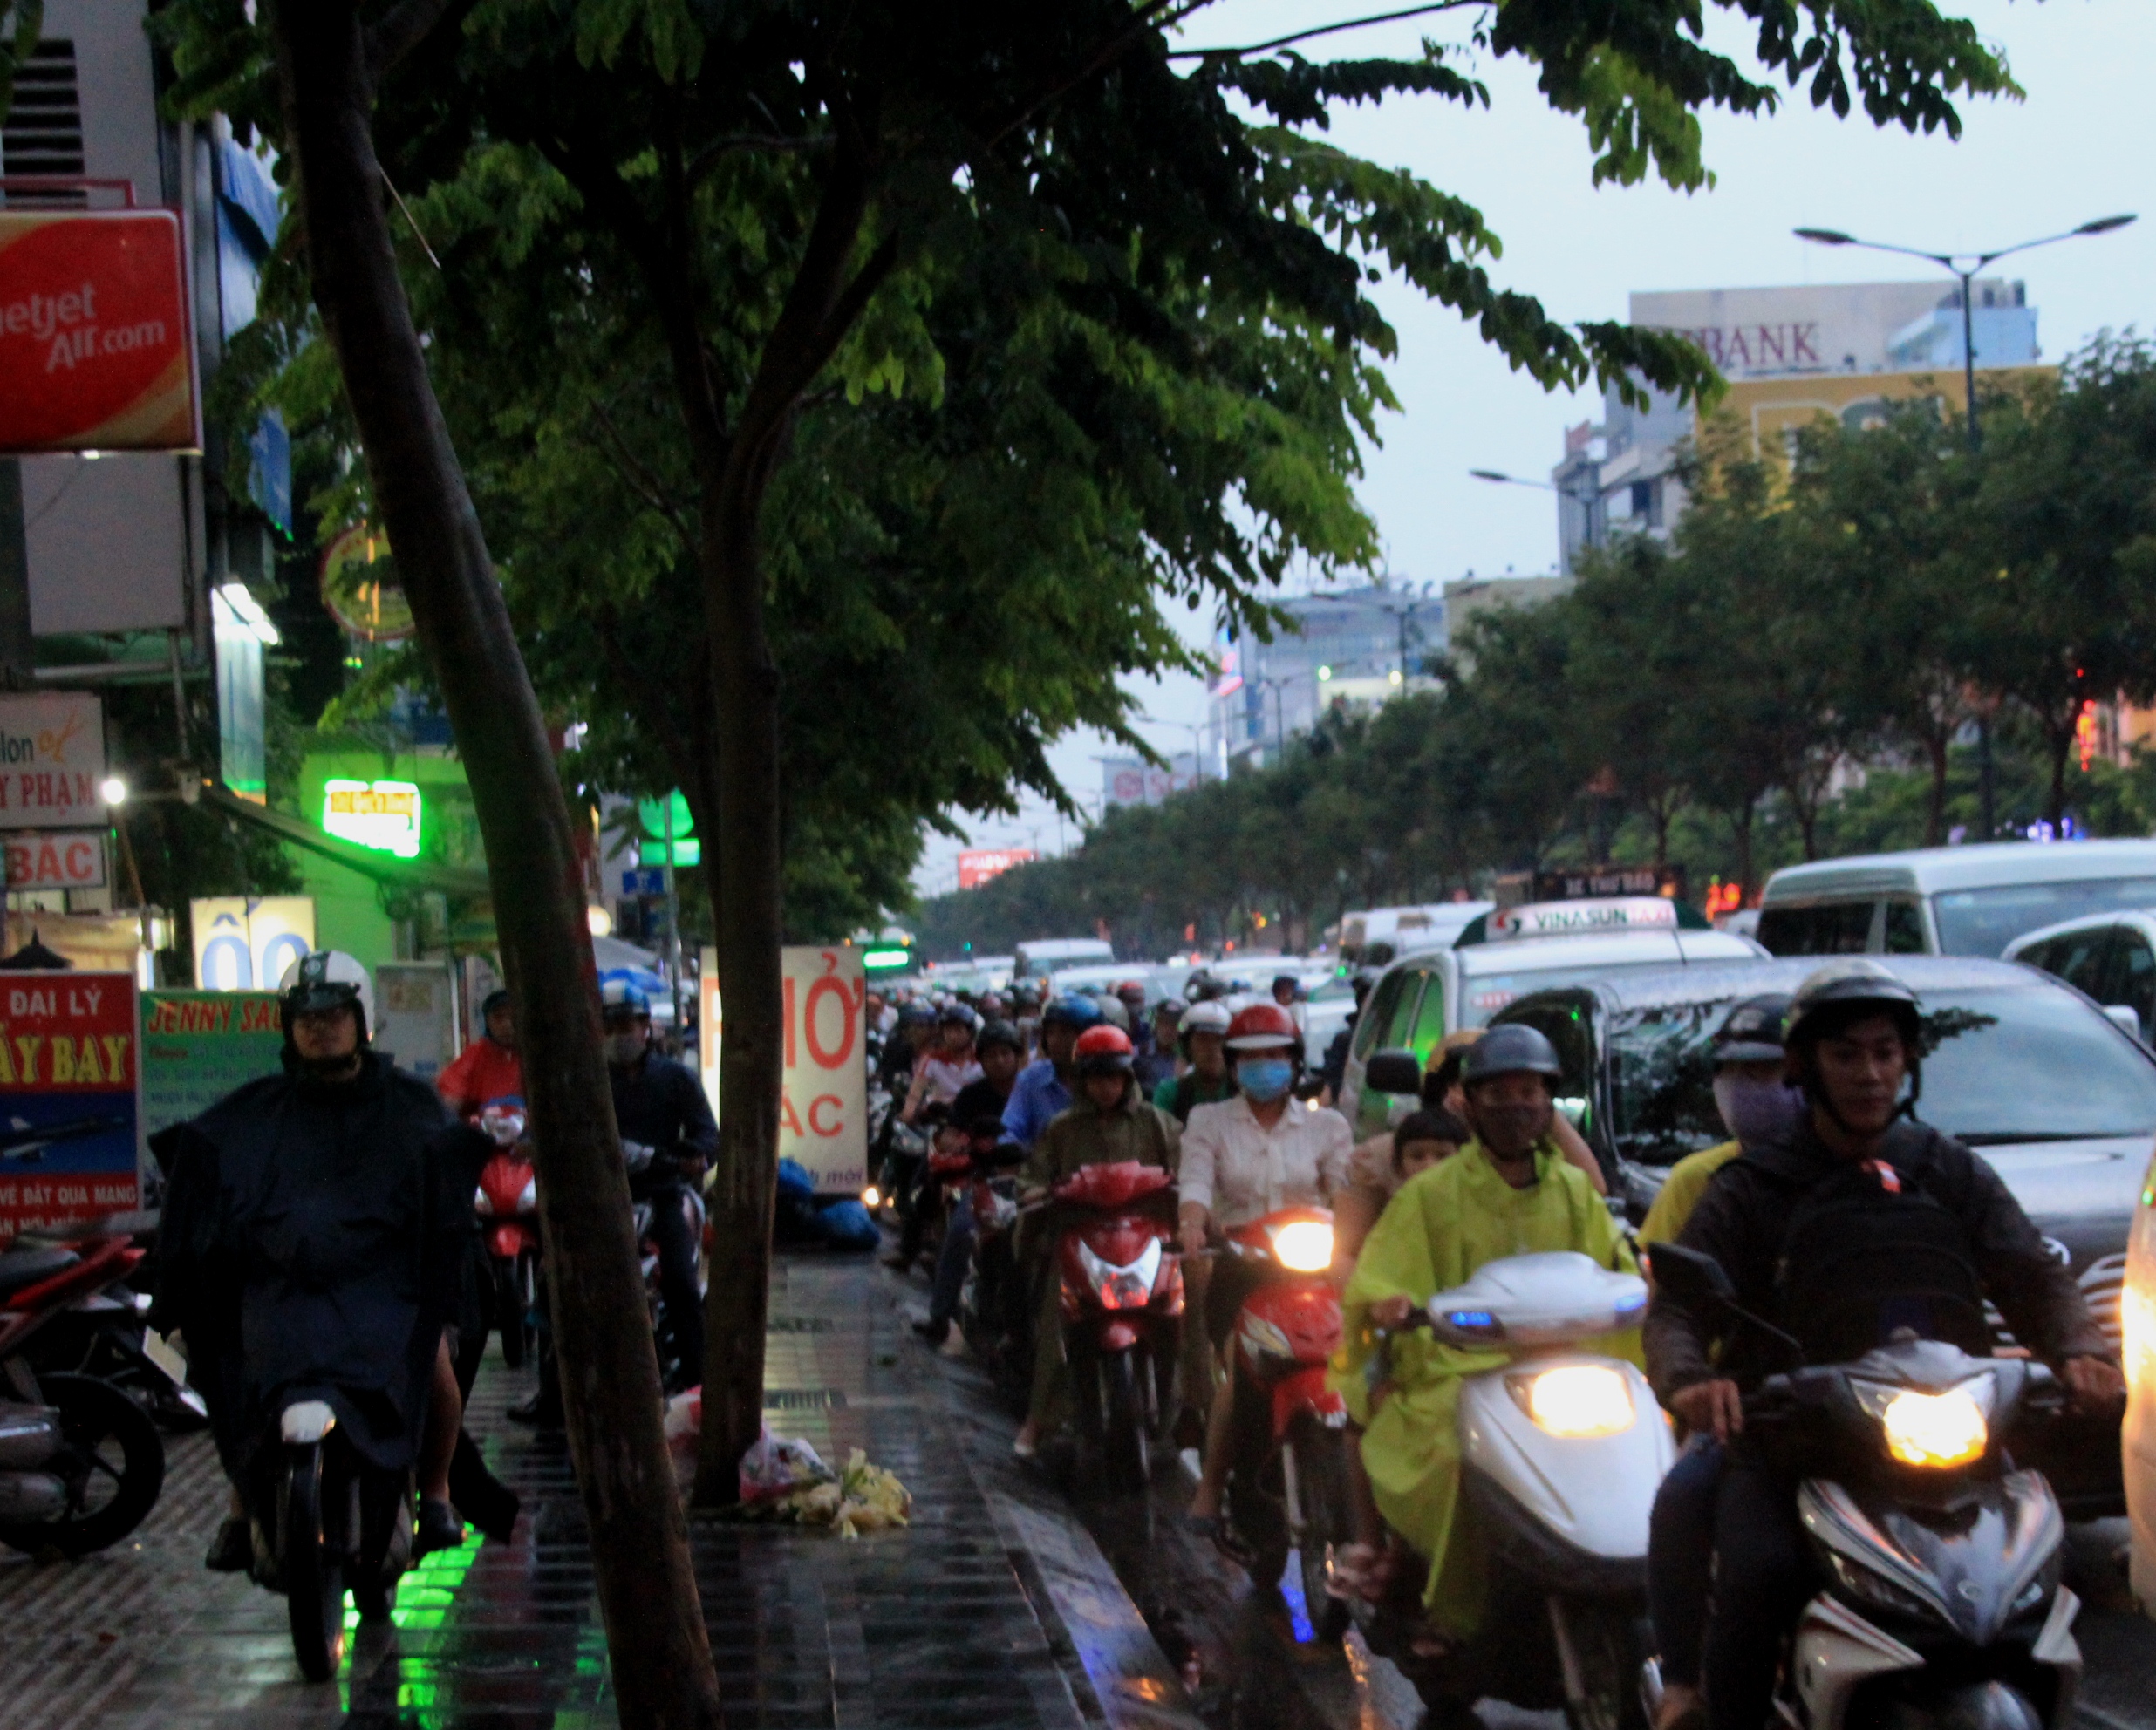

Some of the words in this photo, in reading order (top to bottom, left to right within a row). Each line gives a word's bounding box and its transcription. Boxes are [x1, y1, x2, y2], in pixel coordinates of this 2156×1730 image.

[1699, 323, 1820, 367] BANK
[1535, 908, 1628, 929] VINASUN
[147, 1000, 231, 1033] JENNY
[51, 1034, 129, 1084] BAY
[57, 1185, 88, 1205] QUA
